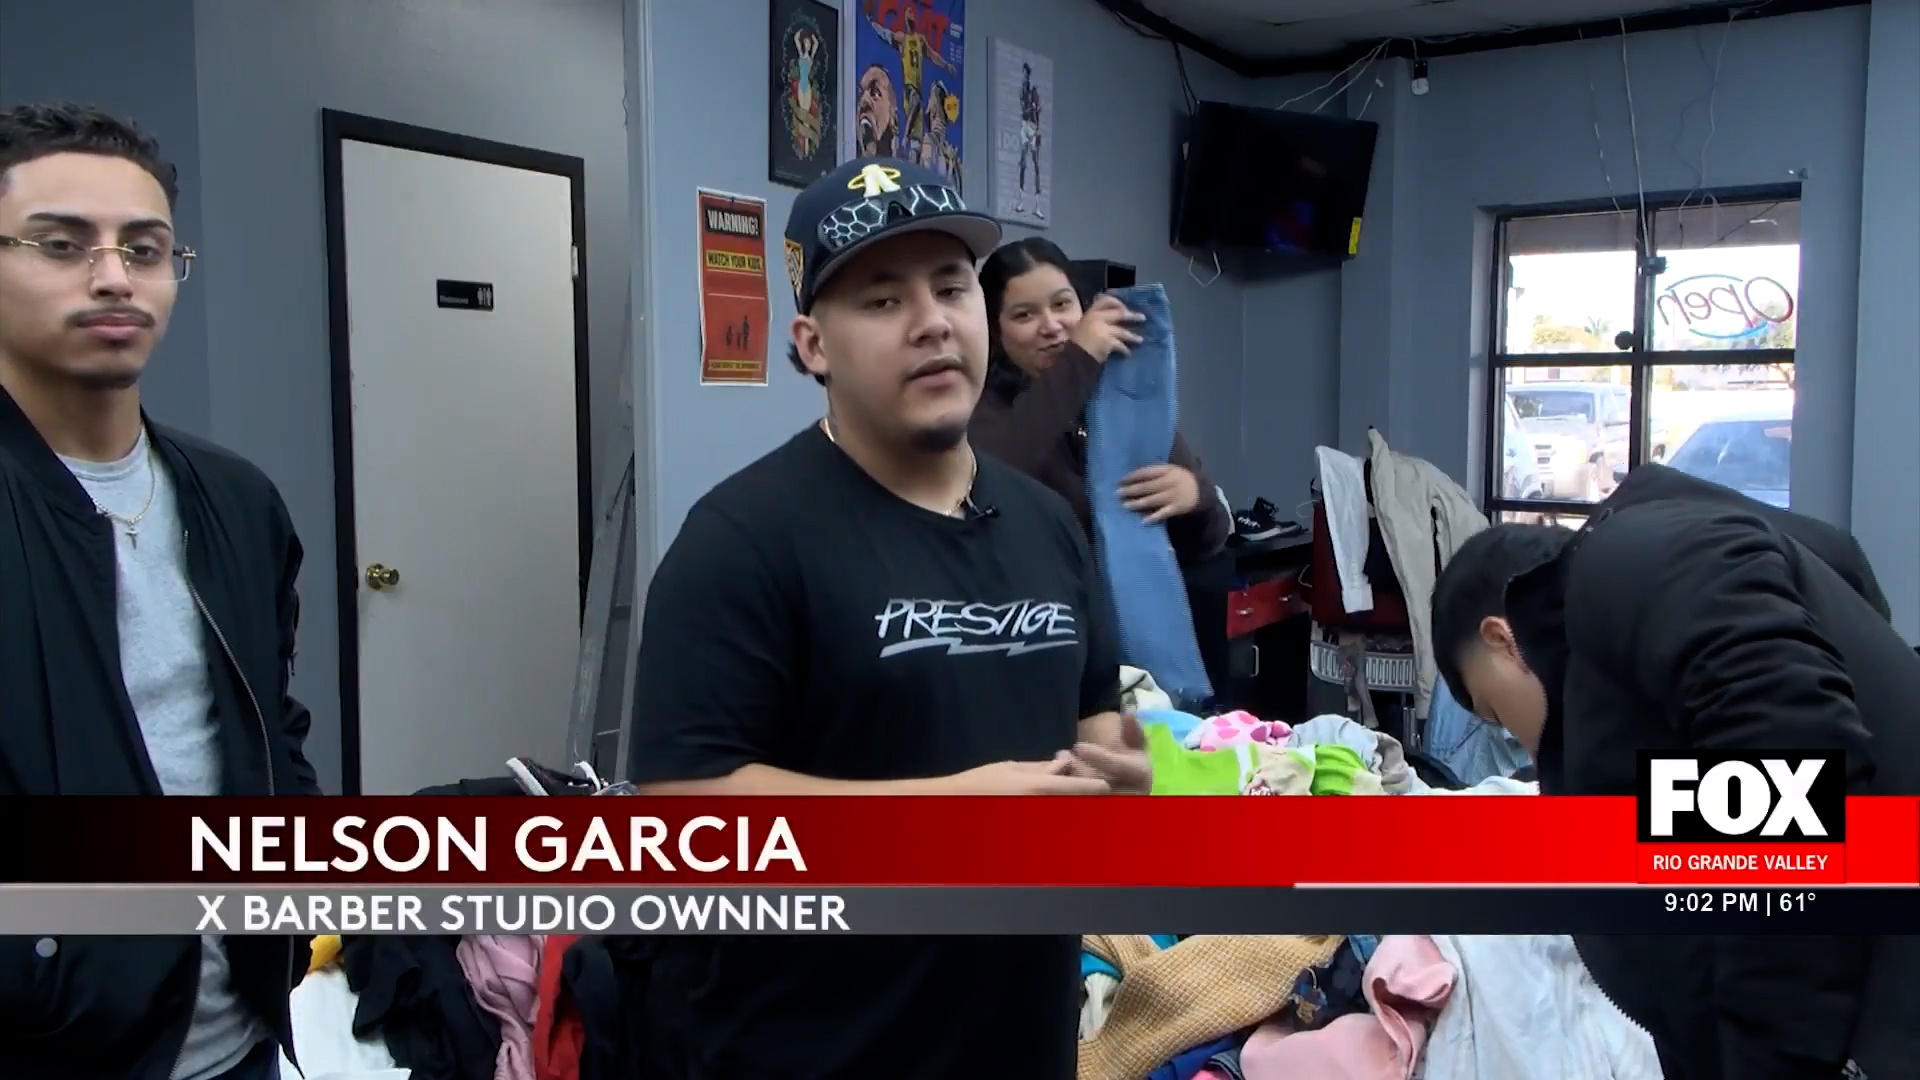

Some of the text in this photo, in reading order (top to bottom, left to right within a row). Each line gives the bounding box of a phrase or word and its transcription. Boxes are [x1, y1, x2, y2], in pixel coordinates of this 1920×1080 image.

[707, 209, 760, 237] WARNING!
[707, 251, 730, 268] WATCH
[730, 254, 747, 269] YOUR
[874, 597, 1077, 638] PRESTIGE
